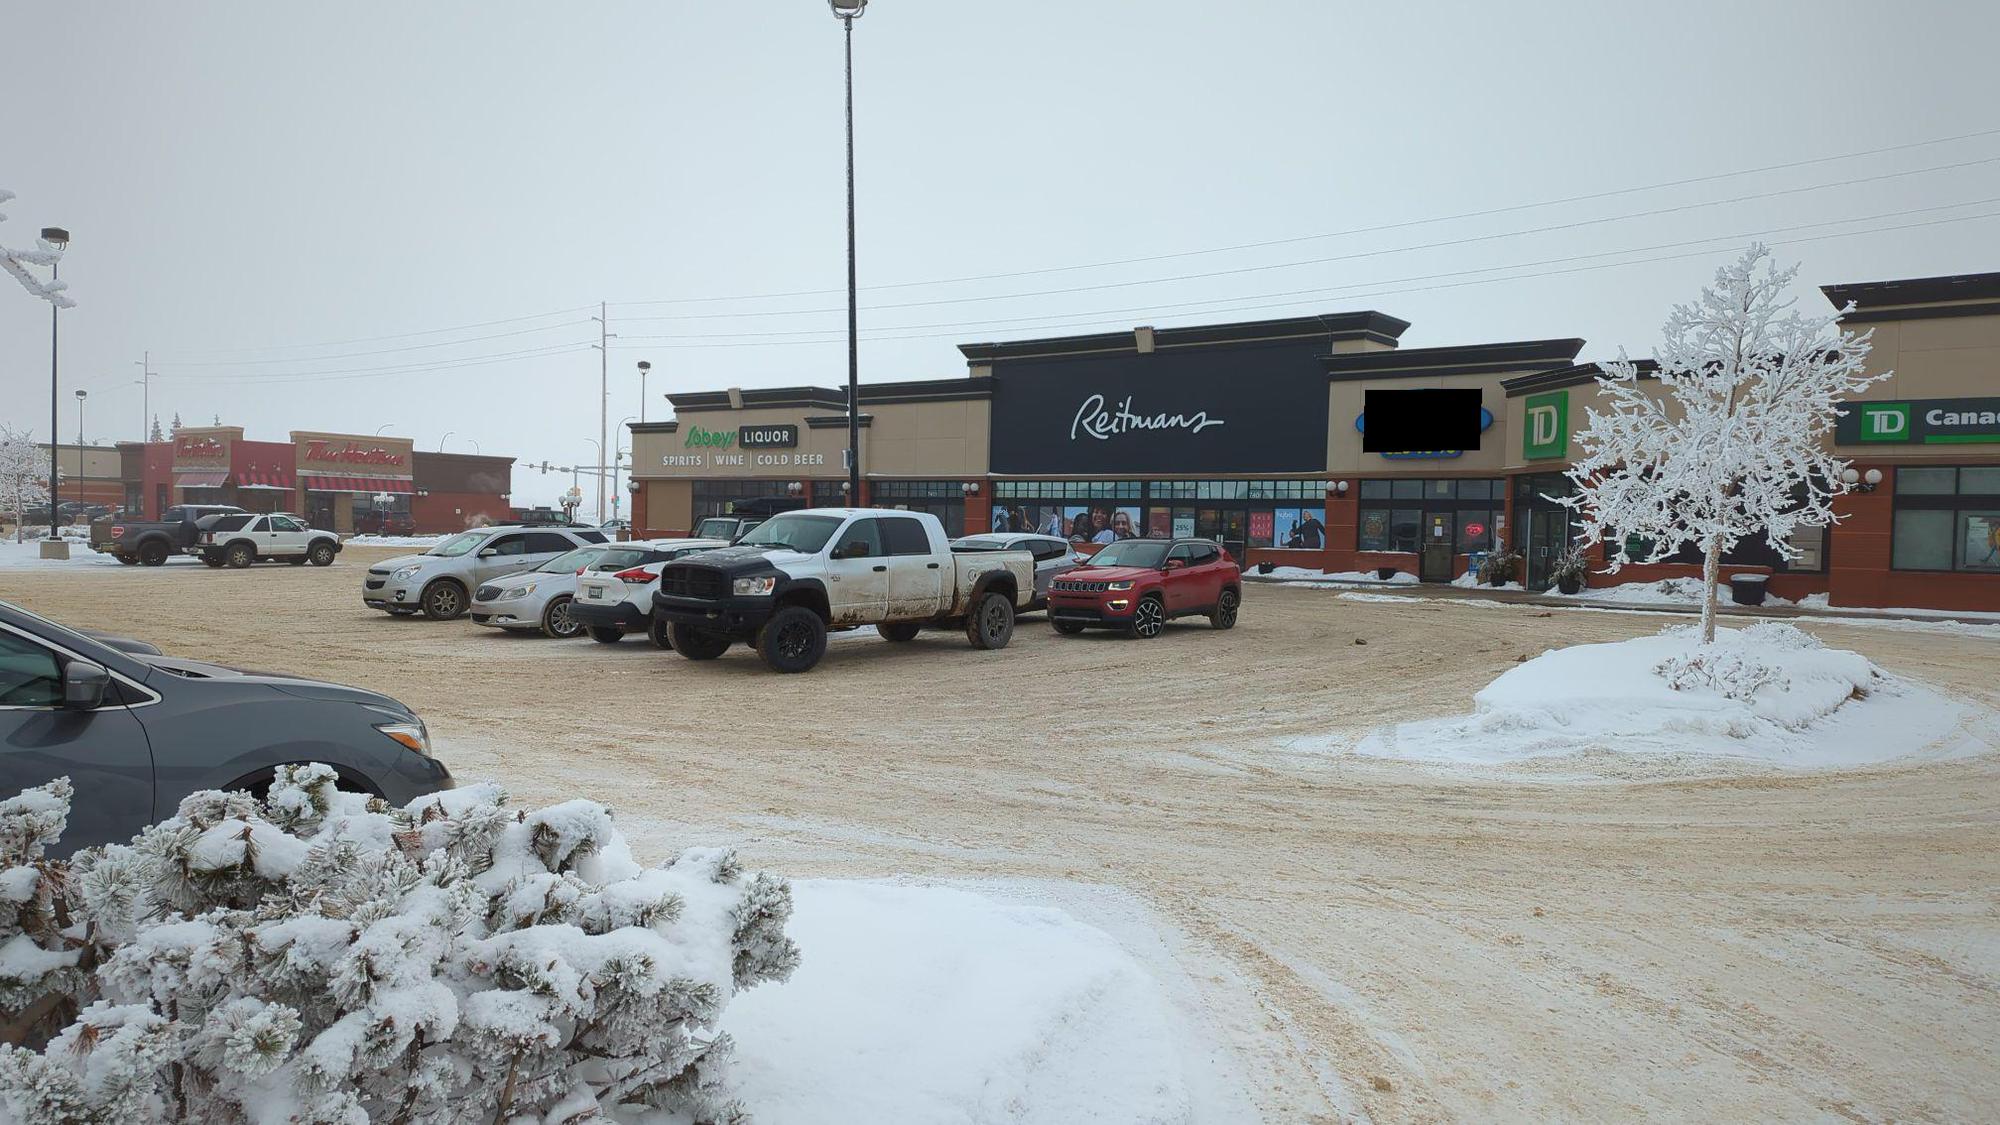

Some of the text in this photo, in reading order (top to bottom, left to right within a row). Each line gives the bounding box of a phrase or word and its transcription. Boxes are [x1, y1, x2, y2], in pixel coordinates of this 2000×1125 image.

[1071, 394, 1225, 440] Reitmans
[1528, 405, 1558, 446] TD
[1866, 409, 2000, 434] TD Cana
[685, 424, 790, 450] Sobeys LIQUOR
[662, 453, 824, 466] SPIRITS WINE COLD BEER
